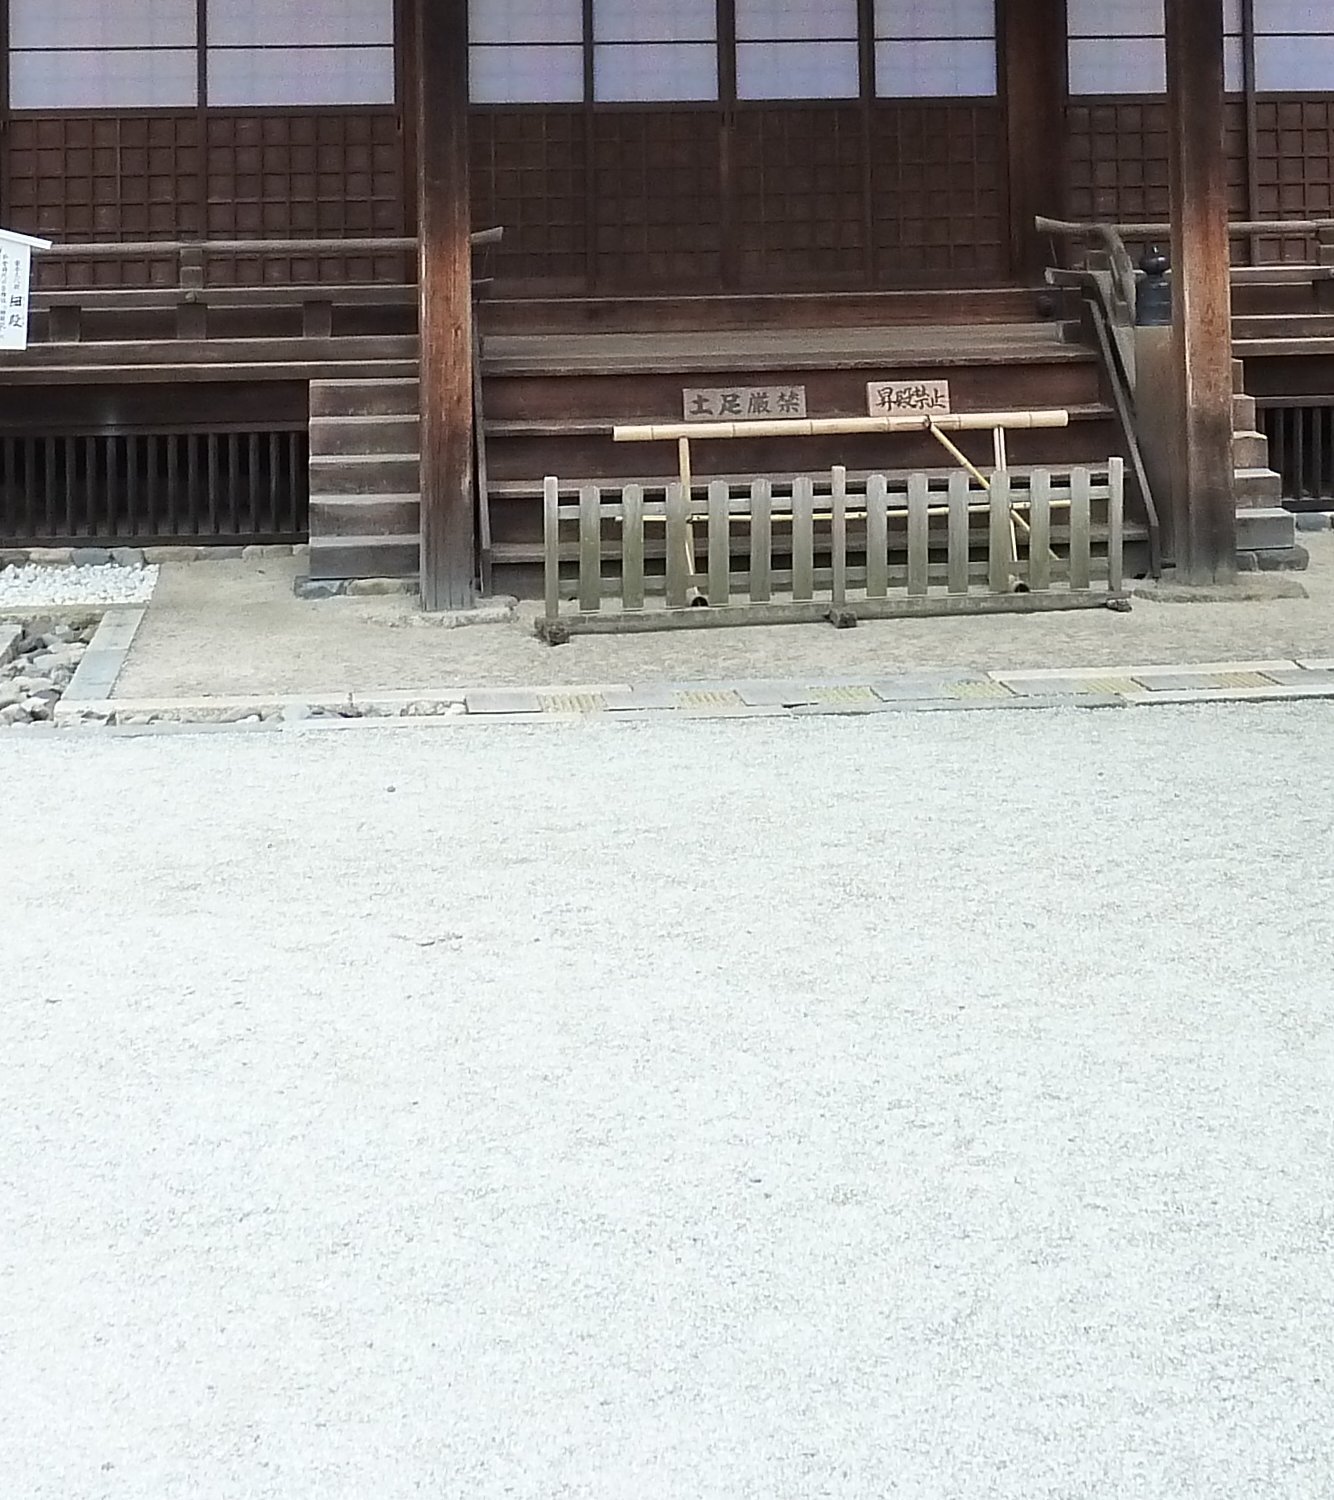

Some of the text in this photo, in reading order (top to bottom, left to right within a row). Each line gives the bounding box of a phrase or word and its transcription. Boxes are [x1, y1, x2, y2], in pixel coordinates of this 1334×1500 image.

[689, 391, 800, 415] 土足厳禁
[875, 384, 946, 411] 昇殿禁止
